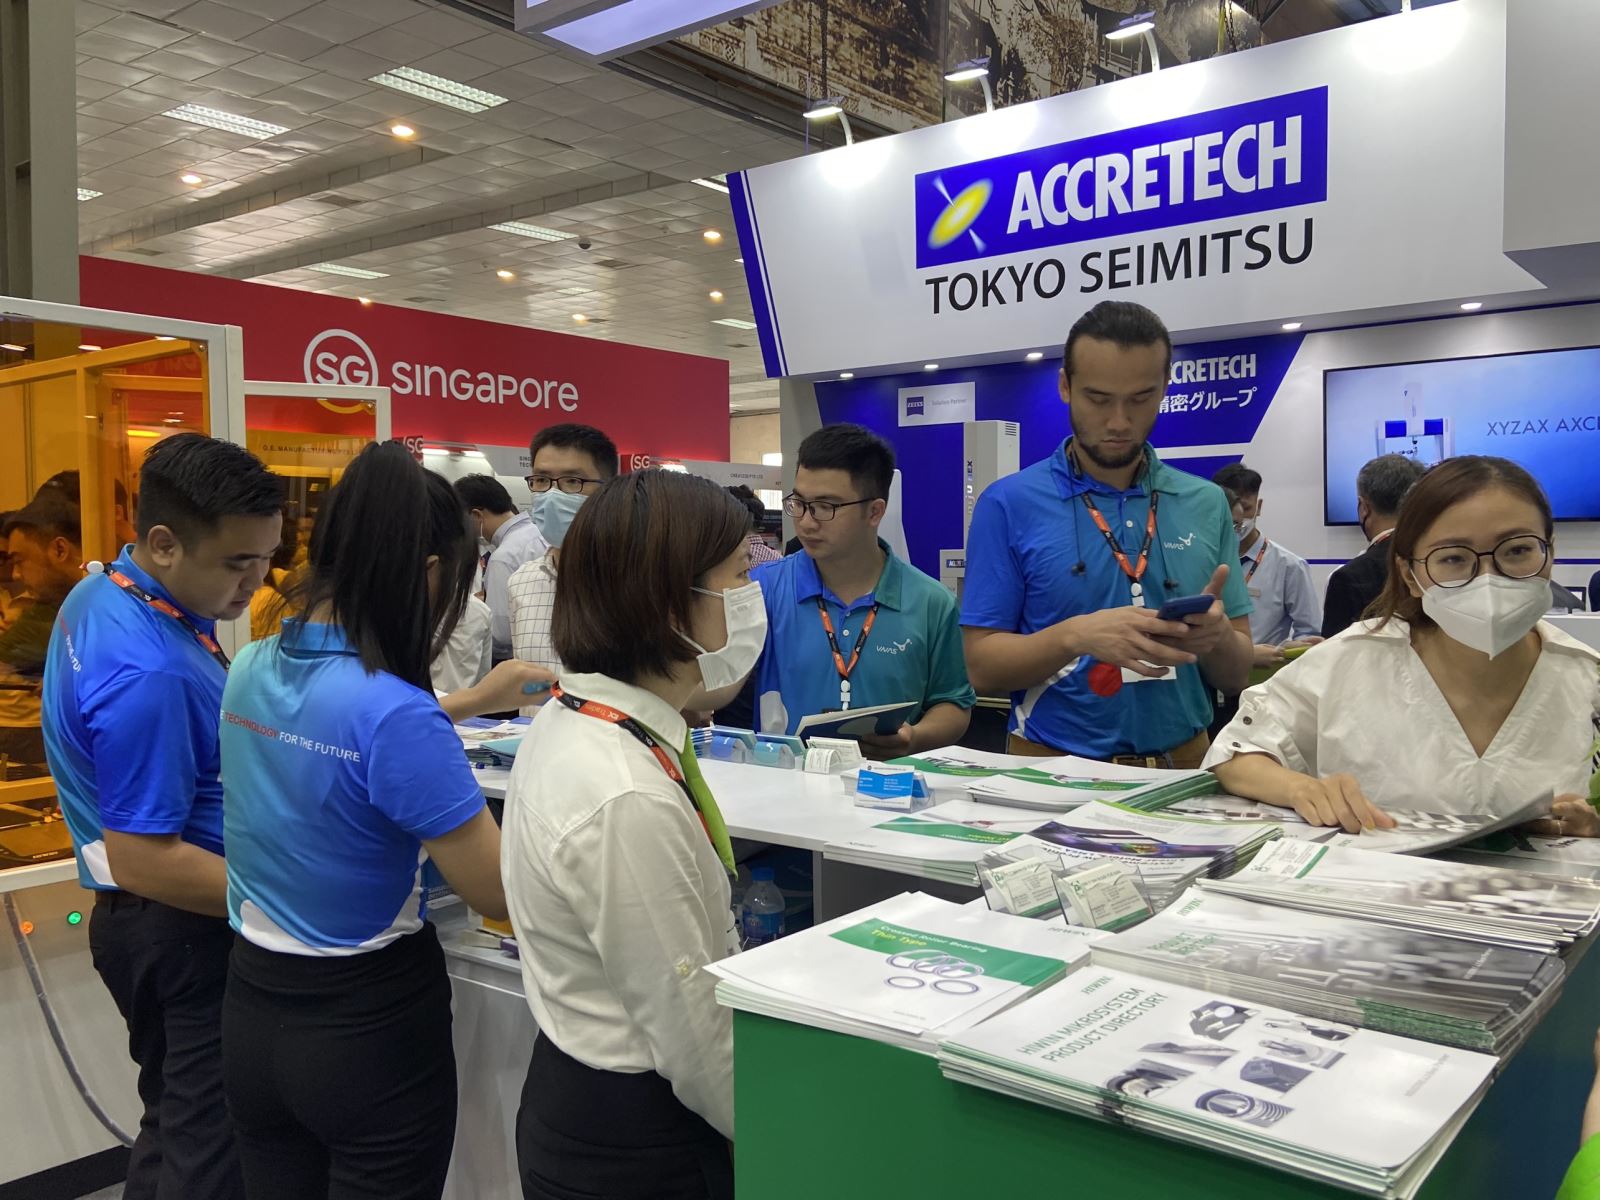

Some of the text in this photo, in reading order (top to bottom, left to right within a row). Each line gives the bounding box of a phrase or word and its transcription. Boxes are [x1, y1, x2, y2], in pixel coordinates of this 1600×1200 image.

[1007, 113, 1302, 235] ACCRETECH
[925, 217, 1314, 314] TOKYO SEIMITSU
[316, 351, 370, 386] SG
[1168, 353, 1256, 385] CRETECH
[1487, 416, 1600, 436] XYZAX AXC
[225, 712, 279, 739] TECHNOLOGY
[279, 731, 298, 745] FOR
[300, 736, 313, 750] THE
[314, 742, 361, 763] FUTURE
[1017, 987, 1145, 1055] HIWIN MIKROSYSTEM
[1041, 992, 1169, 1062] PRODUCT DIRECTORY
